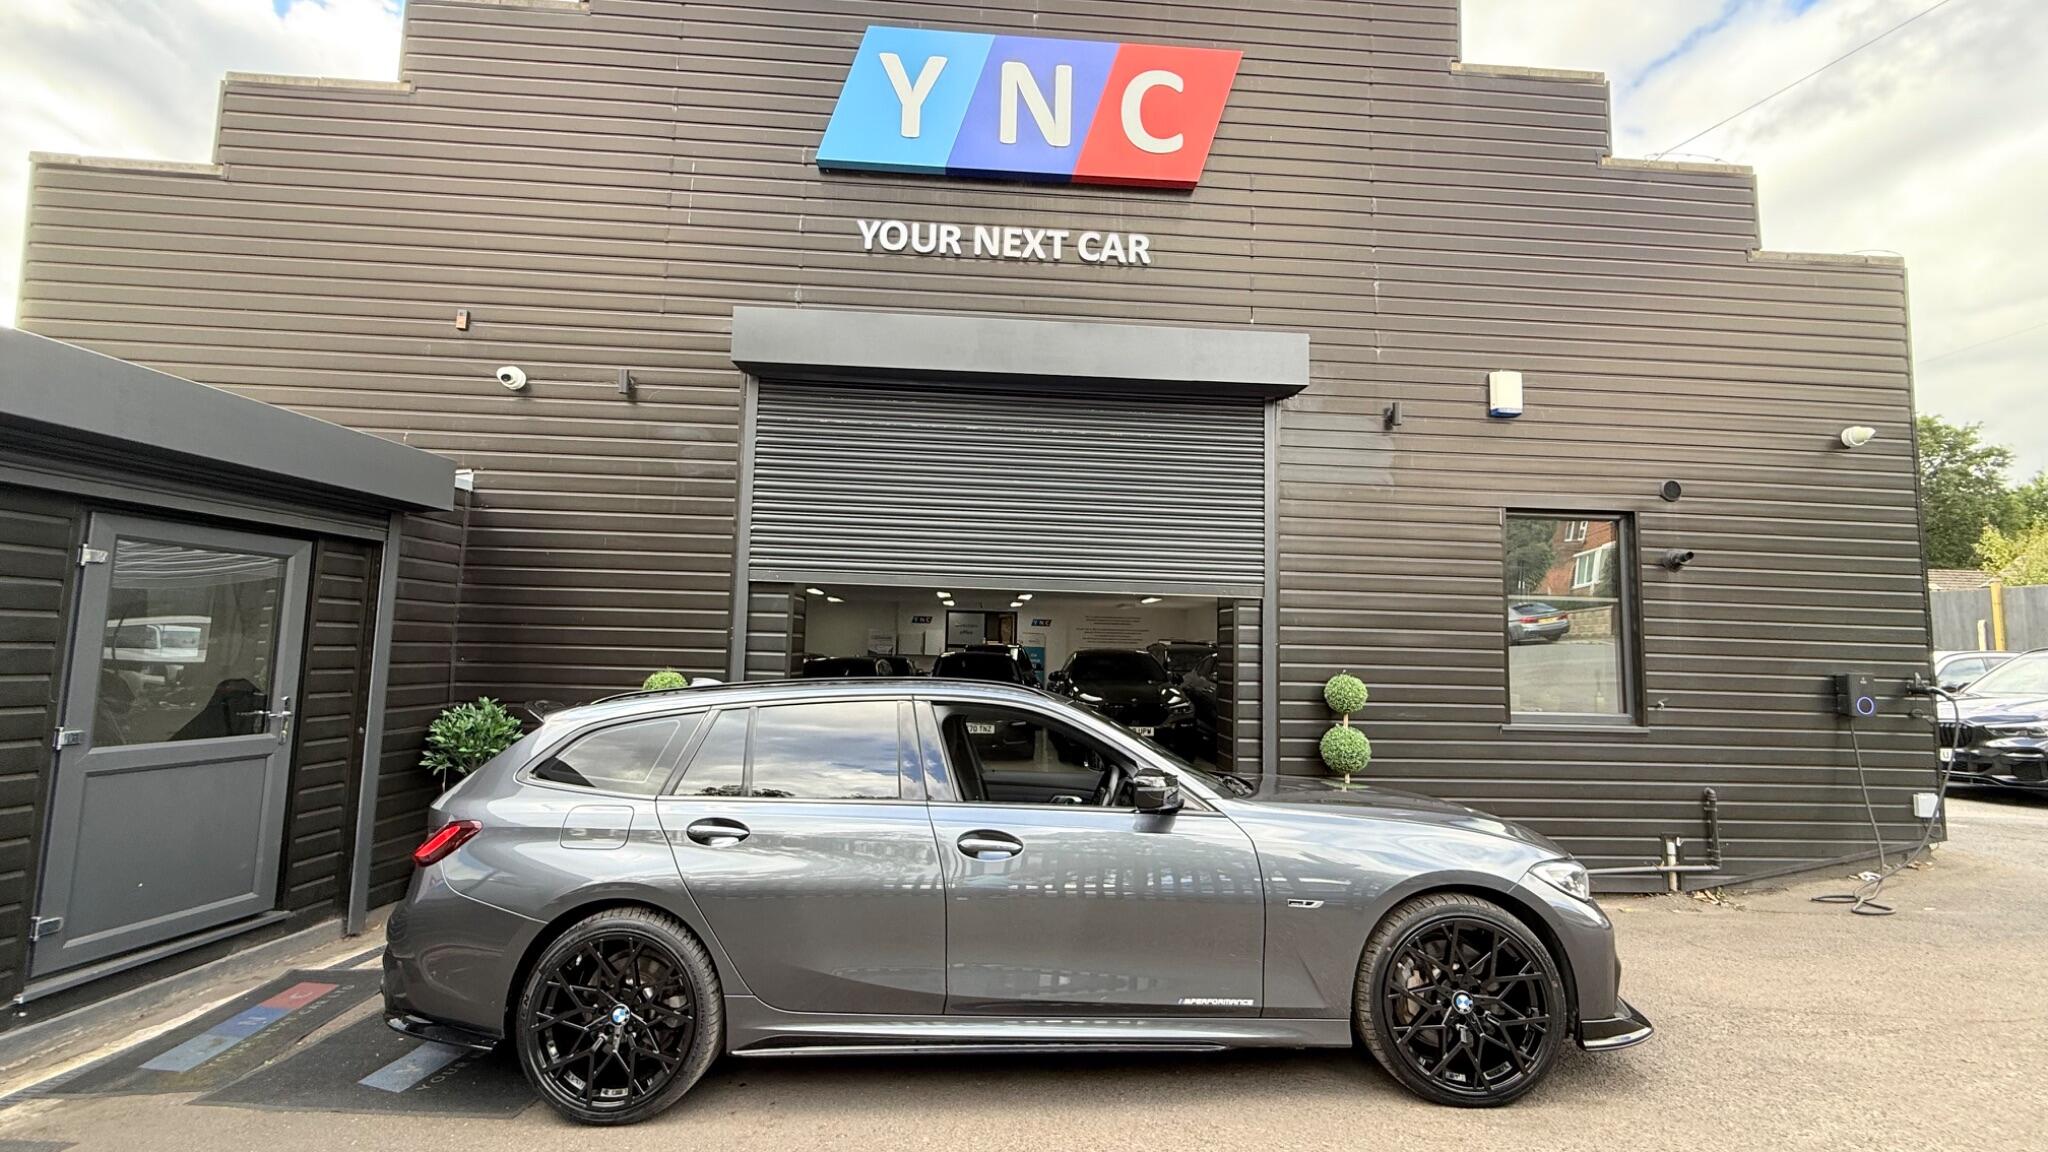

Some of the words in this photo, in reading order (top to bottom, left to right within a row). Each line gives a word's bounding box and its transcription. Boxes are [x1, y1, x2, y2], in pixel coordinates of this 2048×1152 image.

[879, 52, 1185, 154] YNC
[856, 218, 962, 257] YOUR
[973, 225, 1069, 260] NEXT
[1078, 230, 1151, 265] CAR
